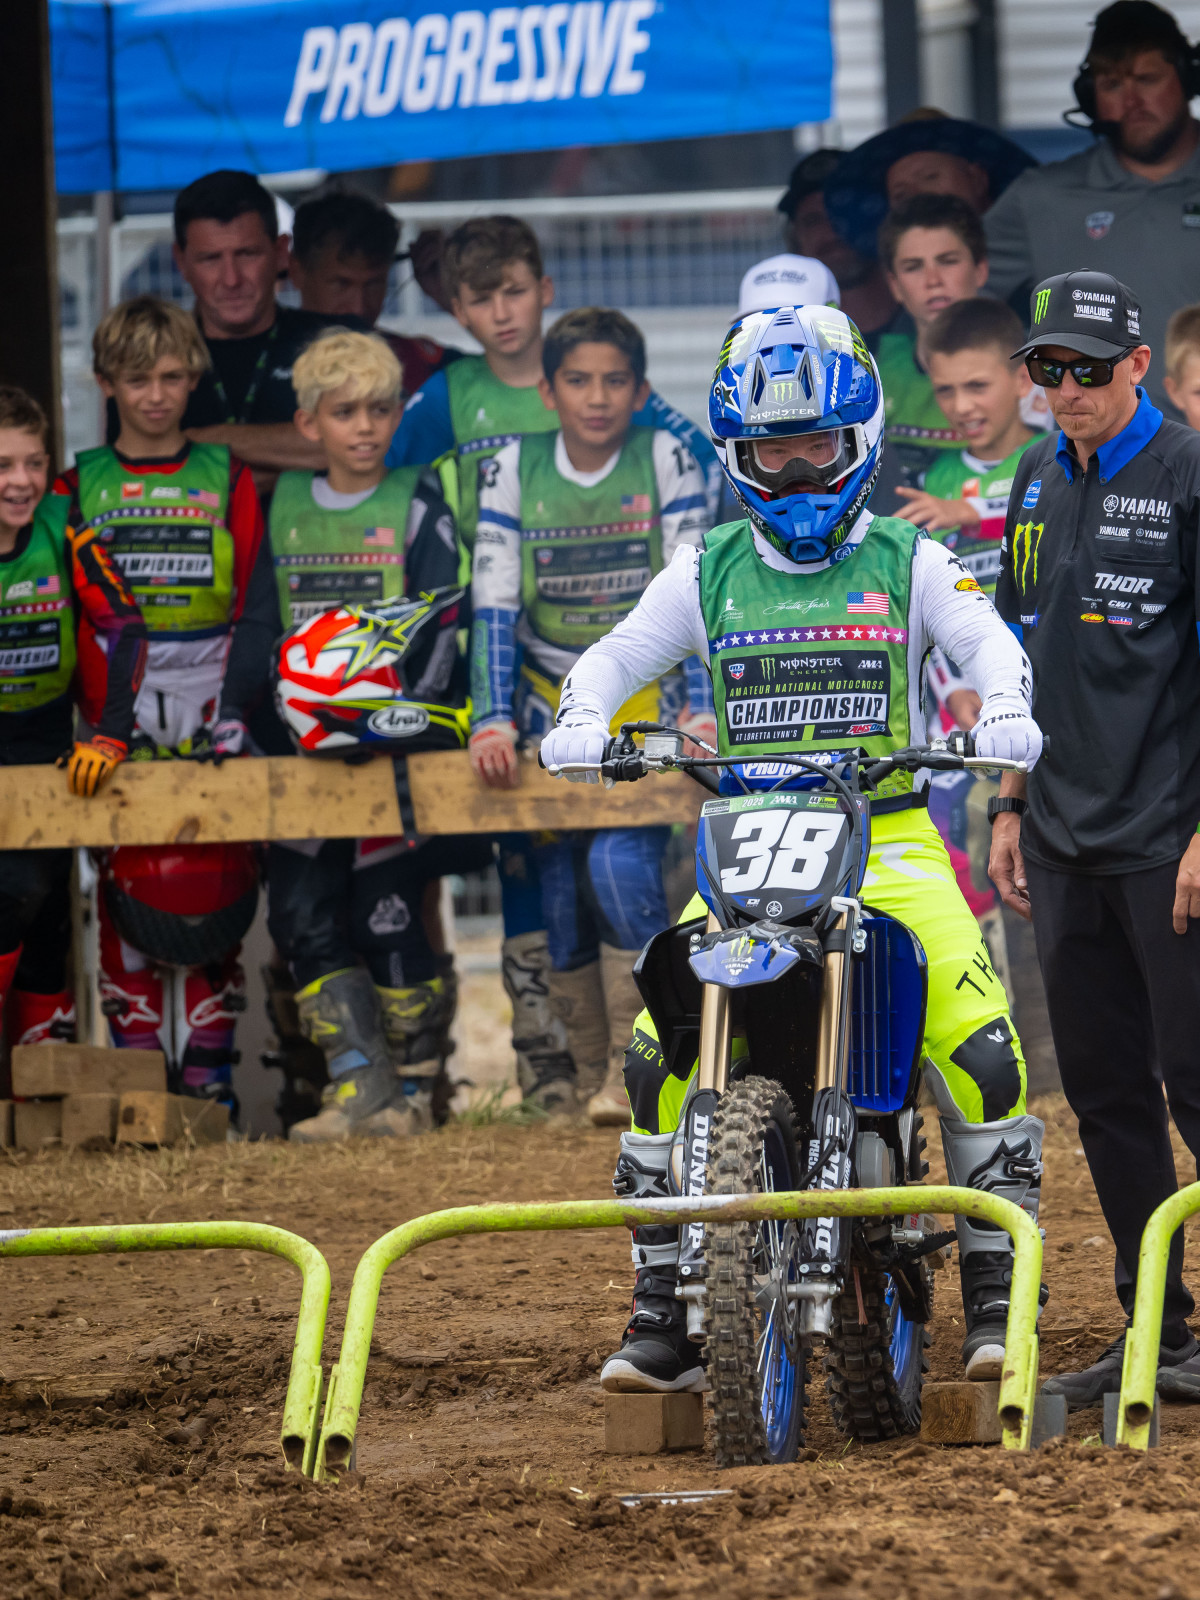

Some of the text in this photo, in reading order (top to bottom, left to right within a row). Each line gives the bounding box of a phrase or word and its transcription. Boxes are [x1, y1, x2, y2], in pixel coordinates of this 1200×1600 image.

[284, 0, 652, 127] PROGRESSIVE
[1083, 291, 1116, 304] YAMAHA
[1075, 304, 1110, 317] YAMALUBE
[750, 408, 817, 420] MONSTER
[1106, 513, 1170, 523] RACING
[1099, 525, 1131, 537] YAMALUBE
[1094, 572, 1154, 594] THOR
[780, 658, 843, 668] MONSTER
[857, 660, 883, 669] AMA
[729, 680, 884, 697] AMATEUR NATIONAL MOTOCROSS
[732, 697, 883, 726] CHAMPIONSHIP
[373, 711, 423, 728] Arai
[744, 732, 771, 741] LORETTA
[773, 730, 798, 739] LYNN'S
[847, 724, 886, 735] AMSOIL
[742, 797, 764, 808] 2025
[770, 796, 798, 804] AMA
[720, 810, 846, 893] 38
